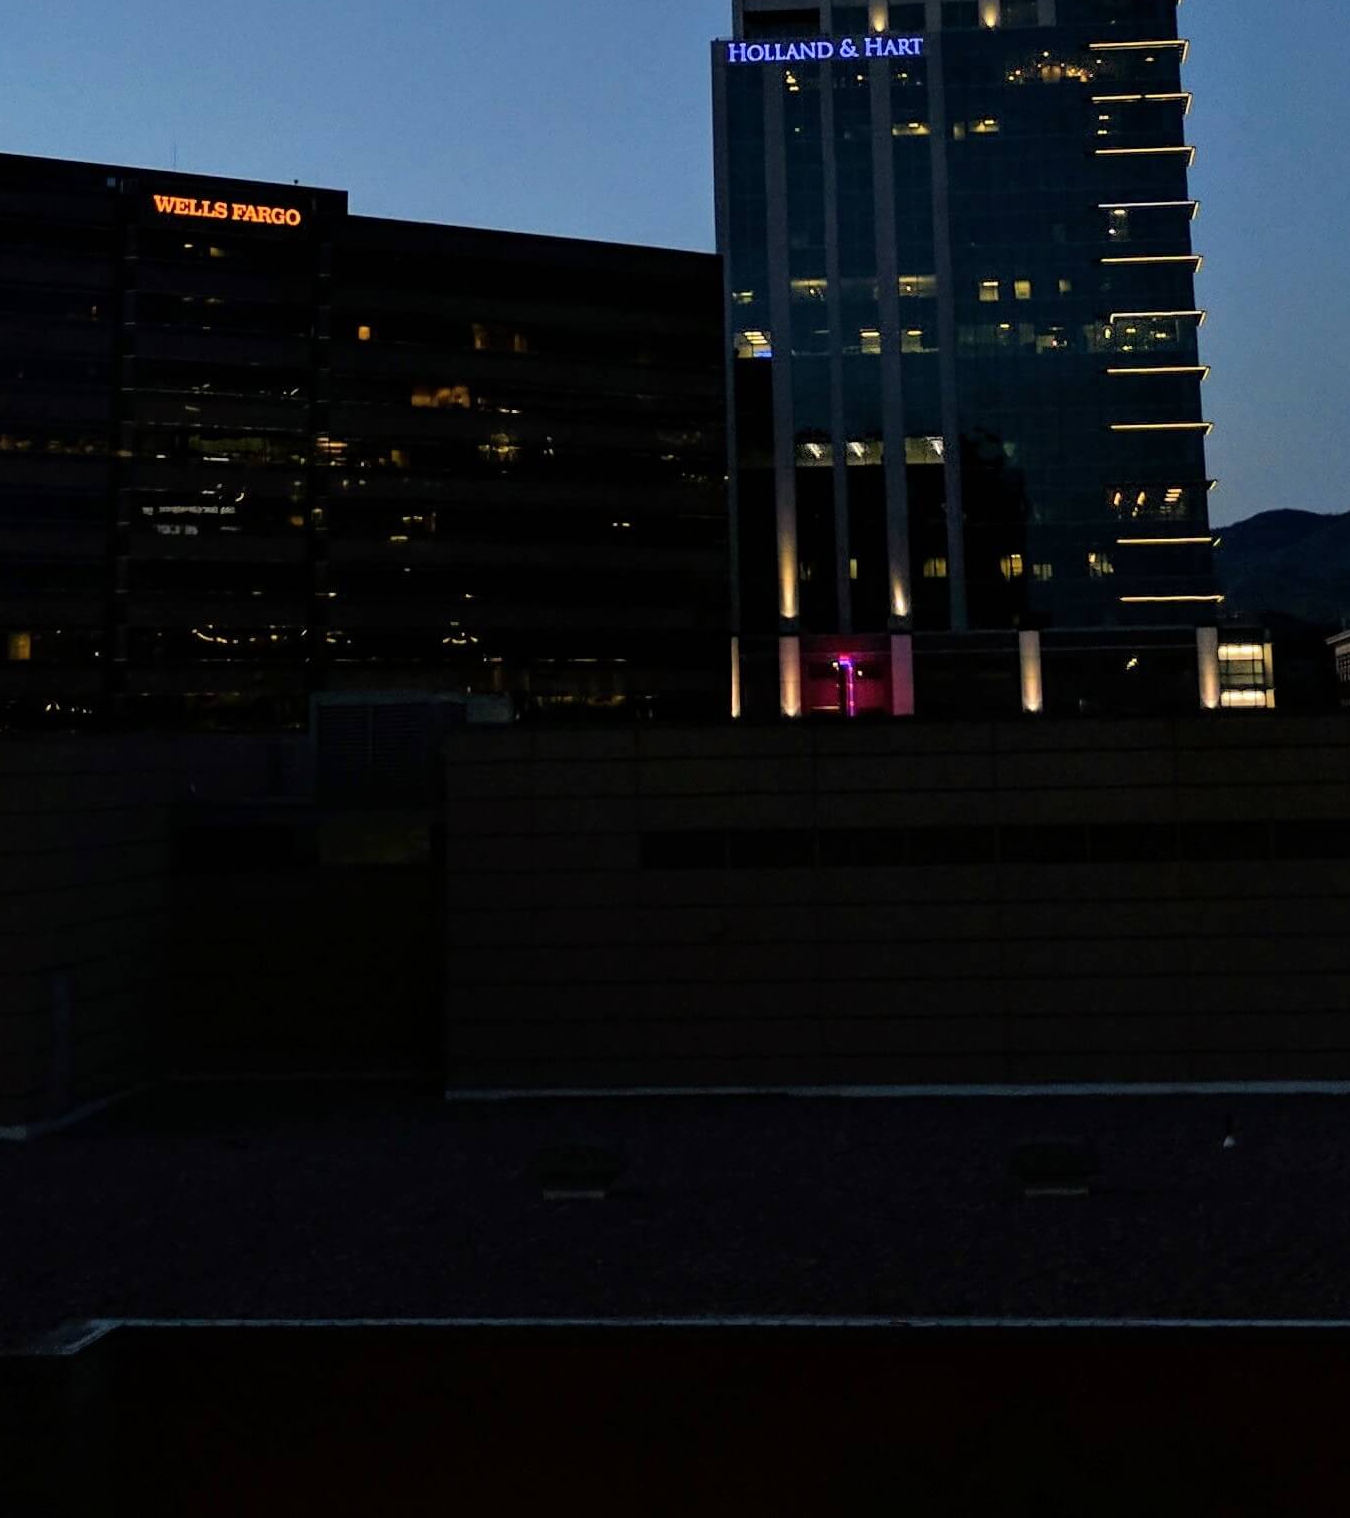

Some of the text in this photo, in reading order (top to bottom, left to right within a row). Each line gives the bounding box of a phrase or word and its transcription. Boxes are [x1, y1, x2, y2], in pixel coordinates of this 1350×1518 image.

[839, 39, 859, 59] &
[153, 194, 301, 226] WELLS FARGO
